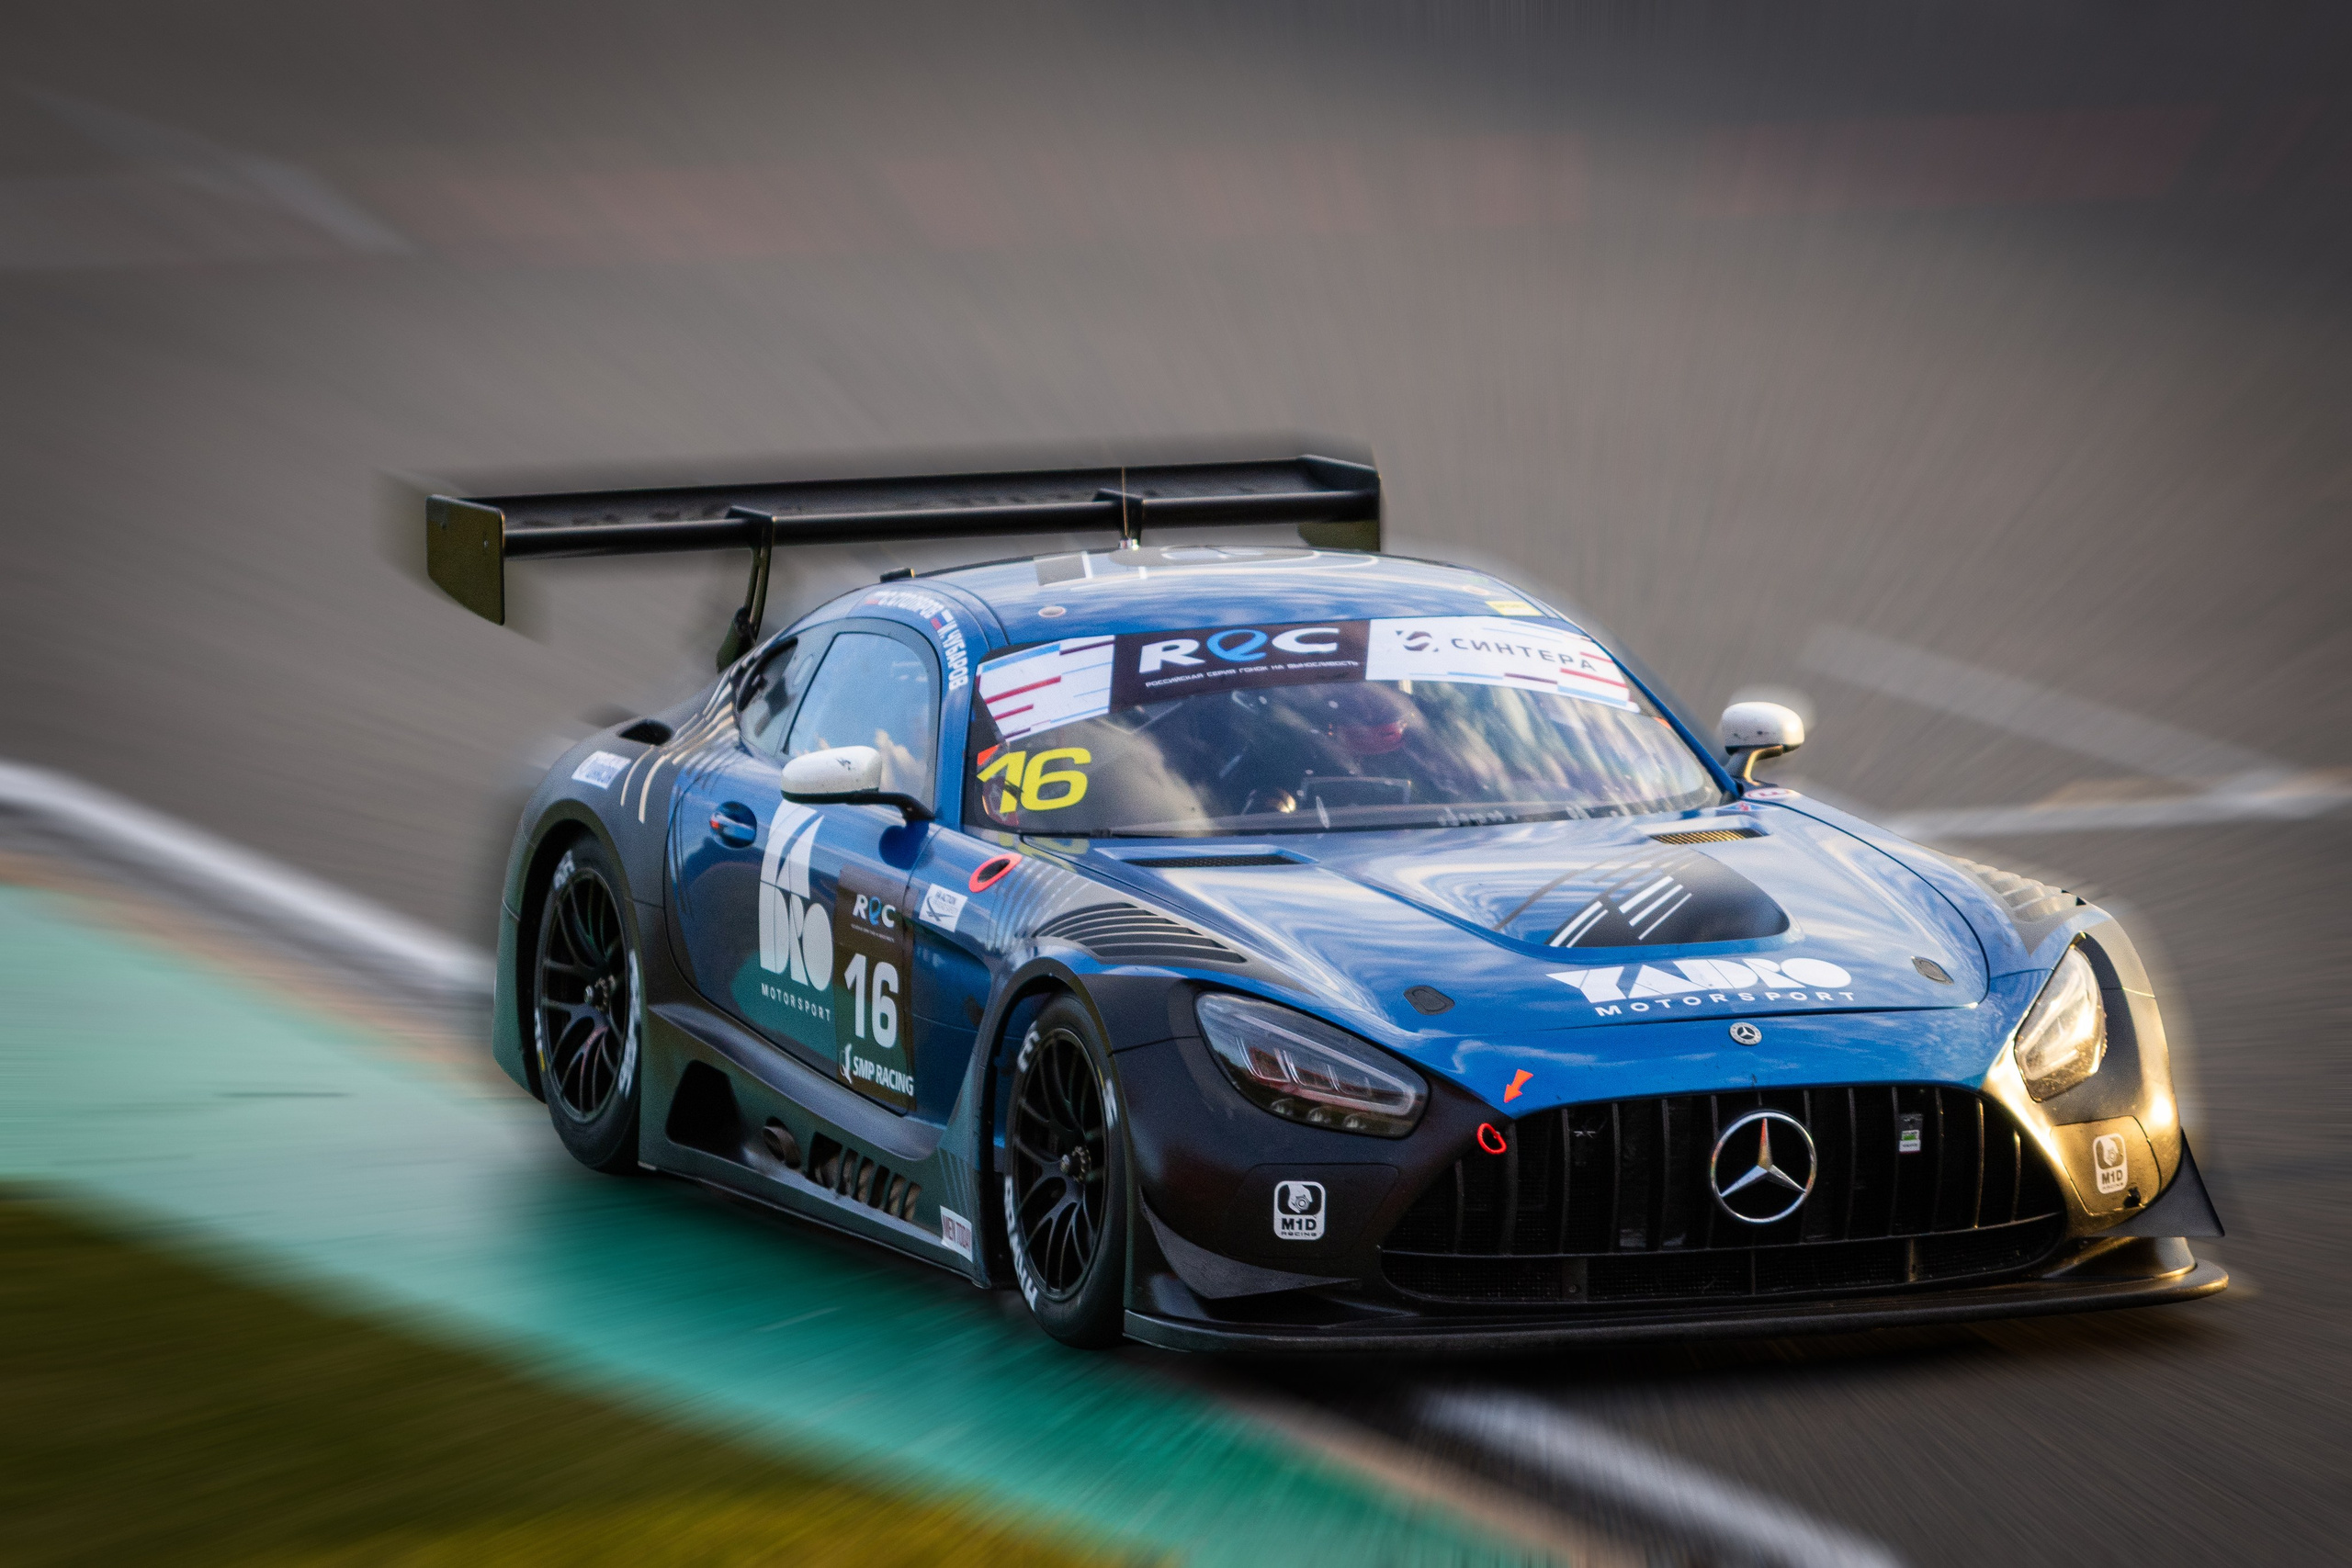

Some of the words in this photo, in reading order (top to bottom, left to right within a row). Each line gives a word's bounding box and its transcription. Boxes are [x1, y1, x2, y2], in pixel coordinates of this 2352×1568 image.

[1451, 637, 1597, 671] СИНТЕРА
[1145, 672, 1204, 688] РОССИЙСКАЯ
[1206, 669, 1237, 678] СЕРИЯ
[1238, 665, 1269, 673] ГОНОК
[976, 747, 1091, 814] 16
[761, 982, 831, 1022] MOTORSPORT
[843, 953, 899, 1049] 16
[1594, 991, 1854, 1017] MOTORSPORT
[853, 1055, 874, 1081] SMP
[875, 1064, 914, 1097] RACING
[2101, 1169, 2123, 1185] M1D
[1281, 1217, 1317, 1231] M1D
